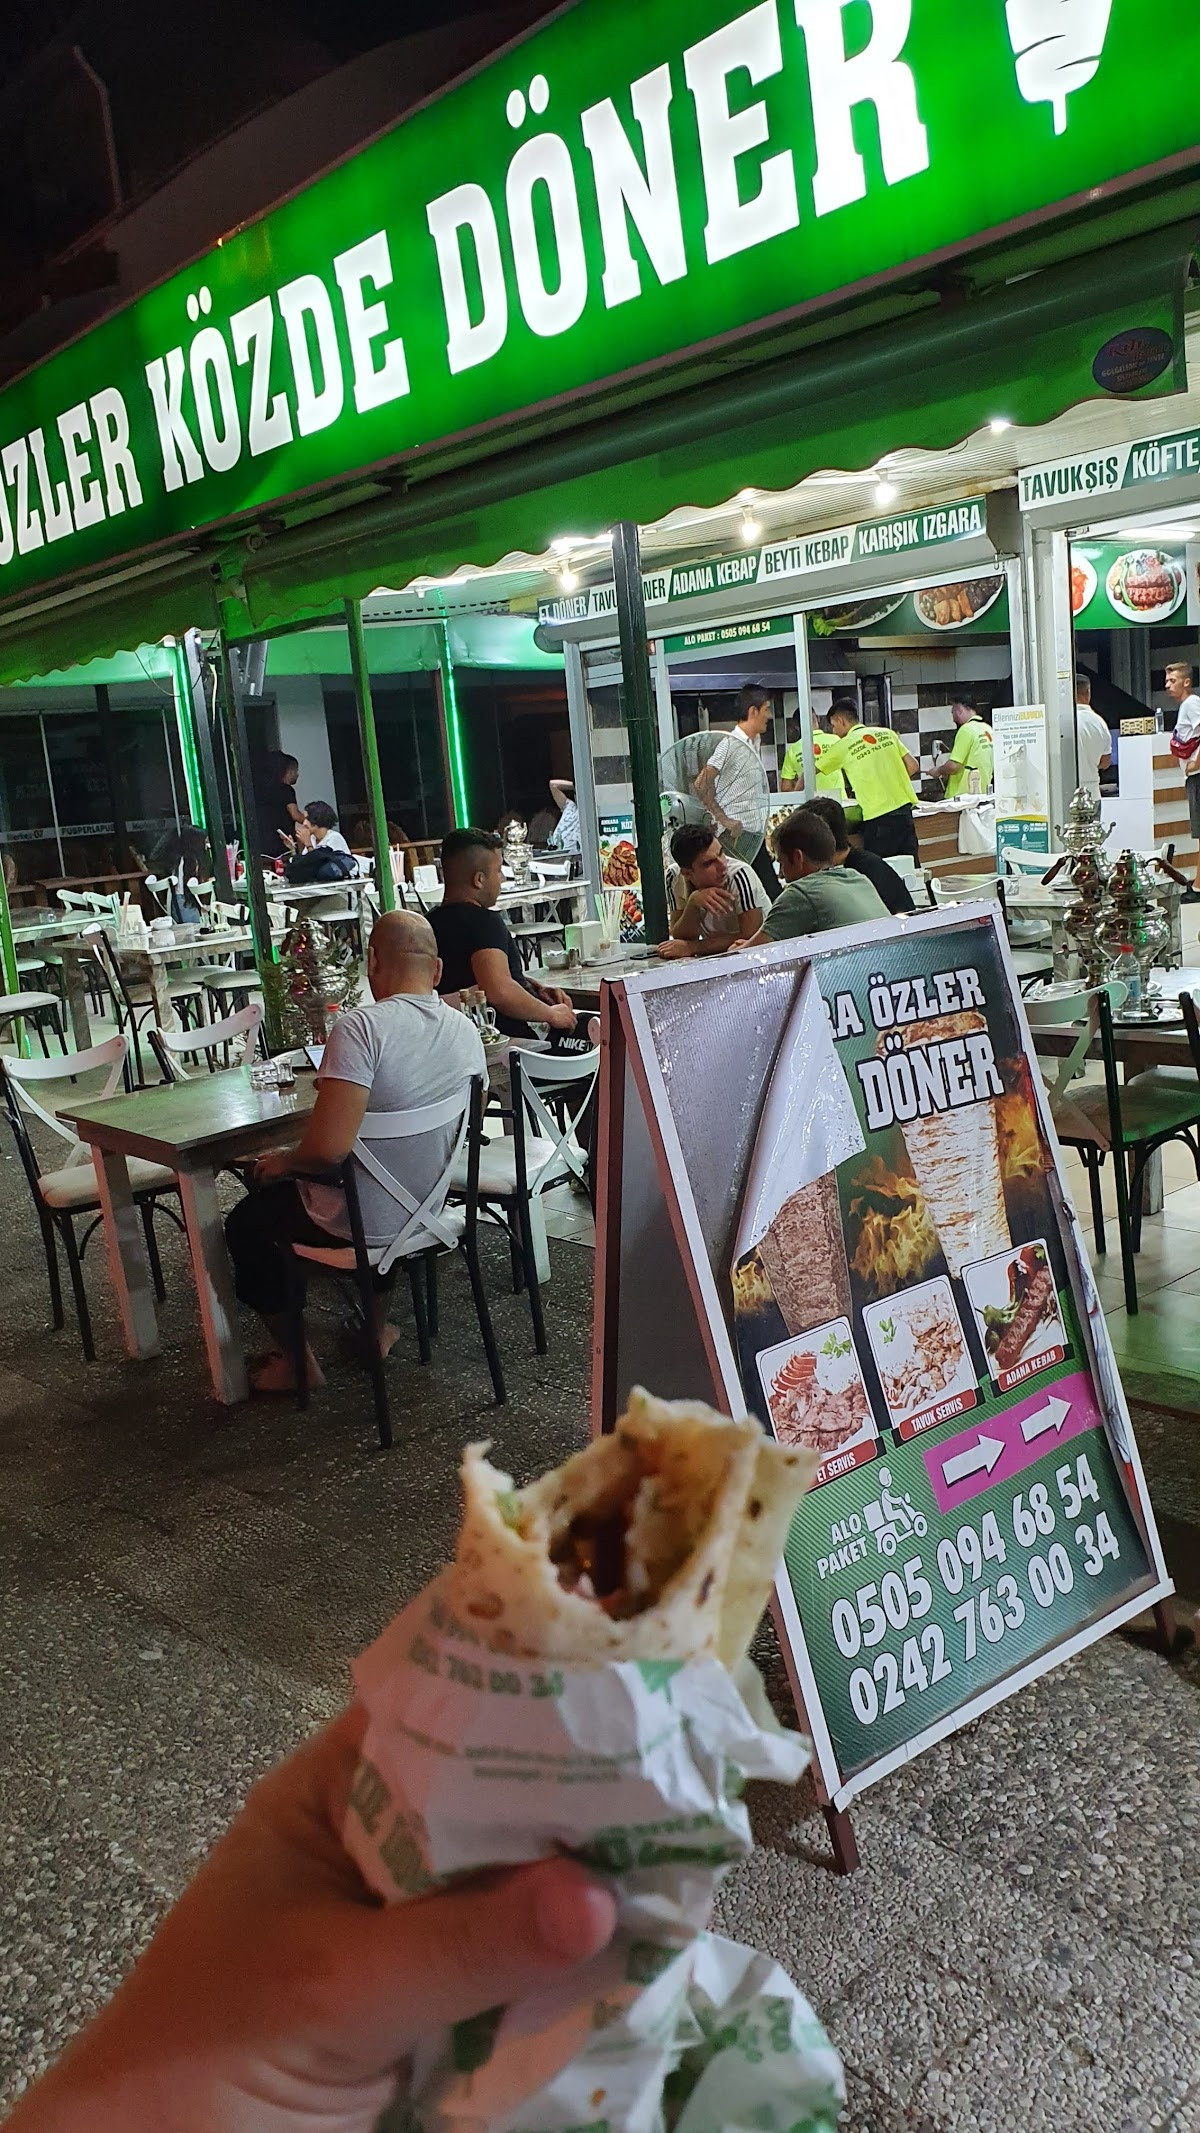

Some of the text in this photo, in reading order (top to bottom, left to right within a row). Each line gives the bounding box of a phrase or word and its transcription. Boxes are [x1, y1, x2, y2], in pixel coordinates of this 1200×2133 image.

[145, 230, 410, 493] KÖZDE
[426, 0, 930, 376] DÖNER
[1132, 436, 1199, 480] KÖFTE
[552, 596, 588, 620] DÖNER
[592, 589, 618, 612] TAVU
[643, 577, 666, 602] NER
[673, 566, 714, 596] ADANA
[716, 556, 757, 586] KEBAP
[805, 535, 849, 567] KEBAP
[859, 518, 920, 555] KARIŞIK
[922, 504, 982, 541] IZGARA
[684, 634, 696, 646] ALO
[697, 631, 717, 645] PAKET
[721, 626, 738, 640] 0505
[738, 624, 751, 637] 094
[752, 622, 762, 634] 68
[762, 621, 771, 632] 54
[869, 968, 986, 1028] ÖZLER
[558, 1036, 586, 1051] NIKE
[857, 1033, 1005, 1130] DÖNER
[1006, 1367, 1031, 1386] ADANA
[910, 1412, 937, 1433] TAVUK
[831, 1513, 861, 1545] ALO
[816, 1536, 868, 1580] PAKET
[831, 1453, 1100, 1659] 0505 094 68 54
[849, 1511, 1121, 1725] 0242 763 00 34
